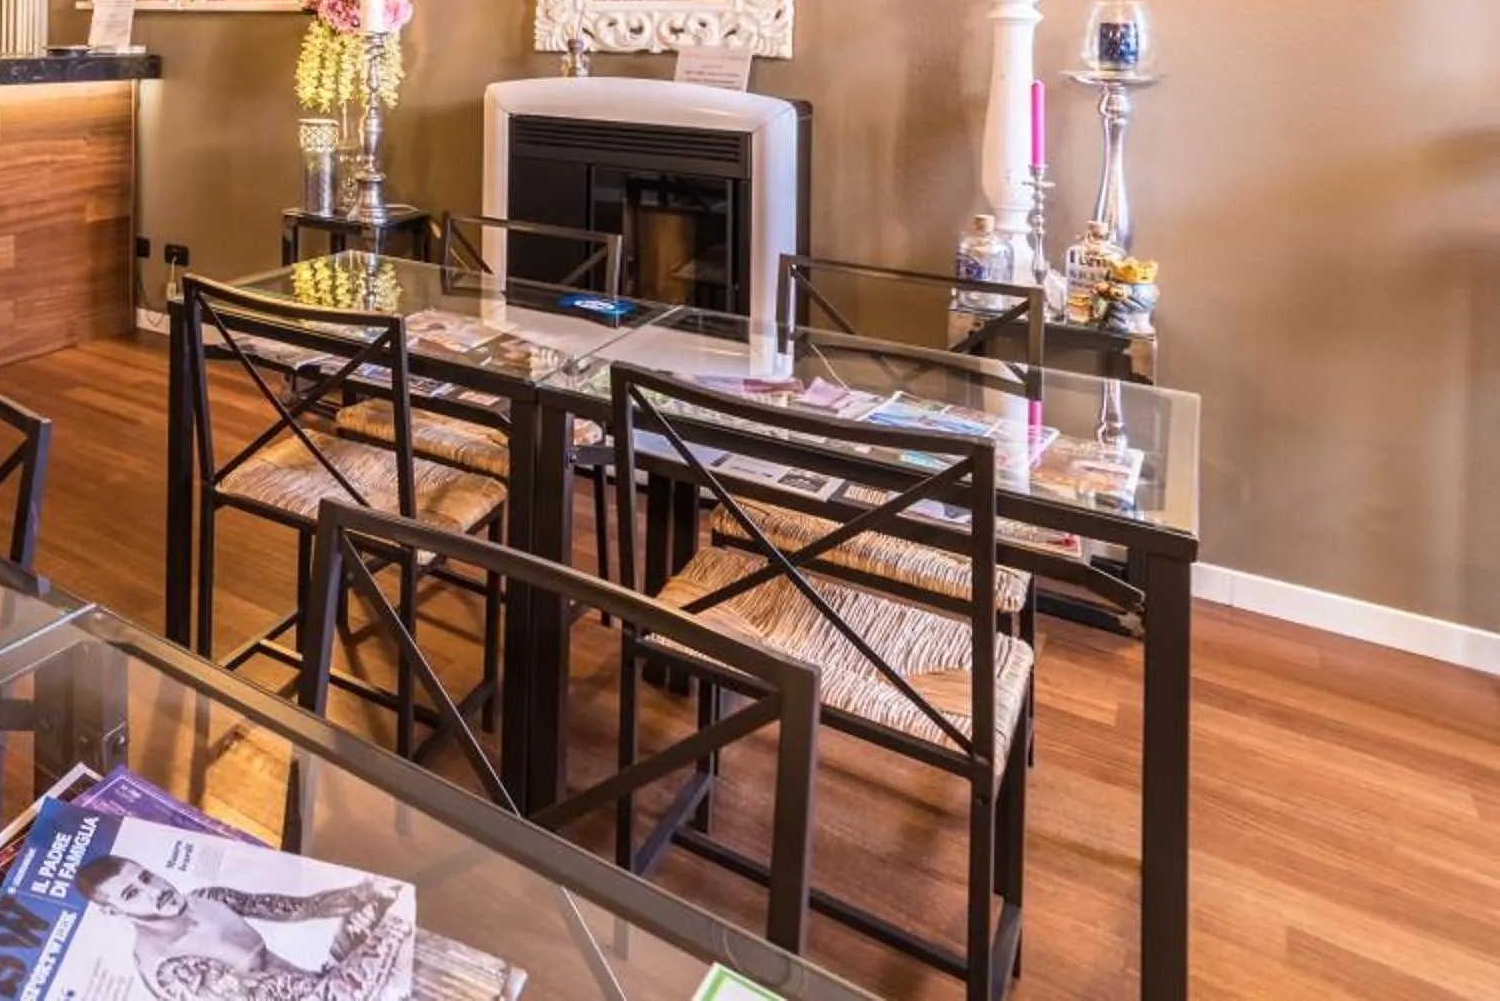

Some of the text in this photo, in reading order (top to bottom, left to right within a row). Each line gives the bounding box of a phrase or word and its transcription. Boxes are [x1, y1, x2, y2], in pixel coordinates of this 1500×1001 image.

[31, 831, 72, 894] IL PADRE
[49, 815, 100, 899] DI FAMIGLIA
